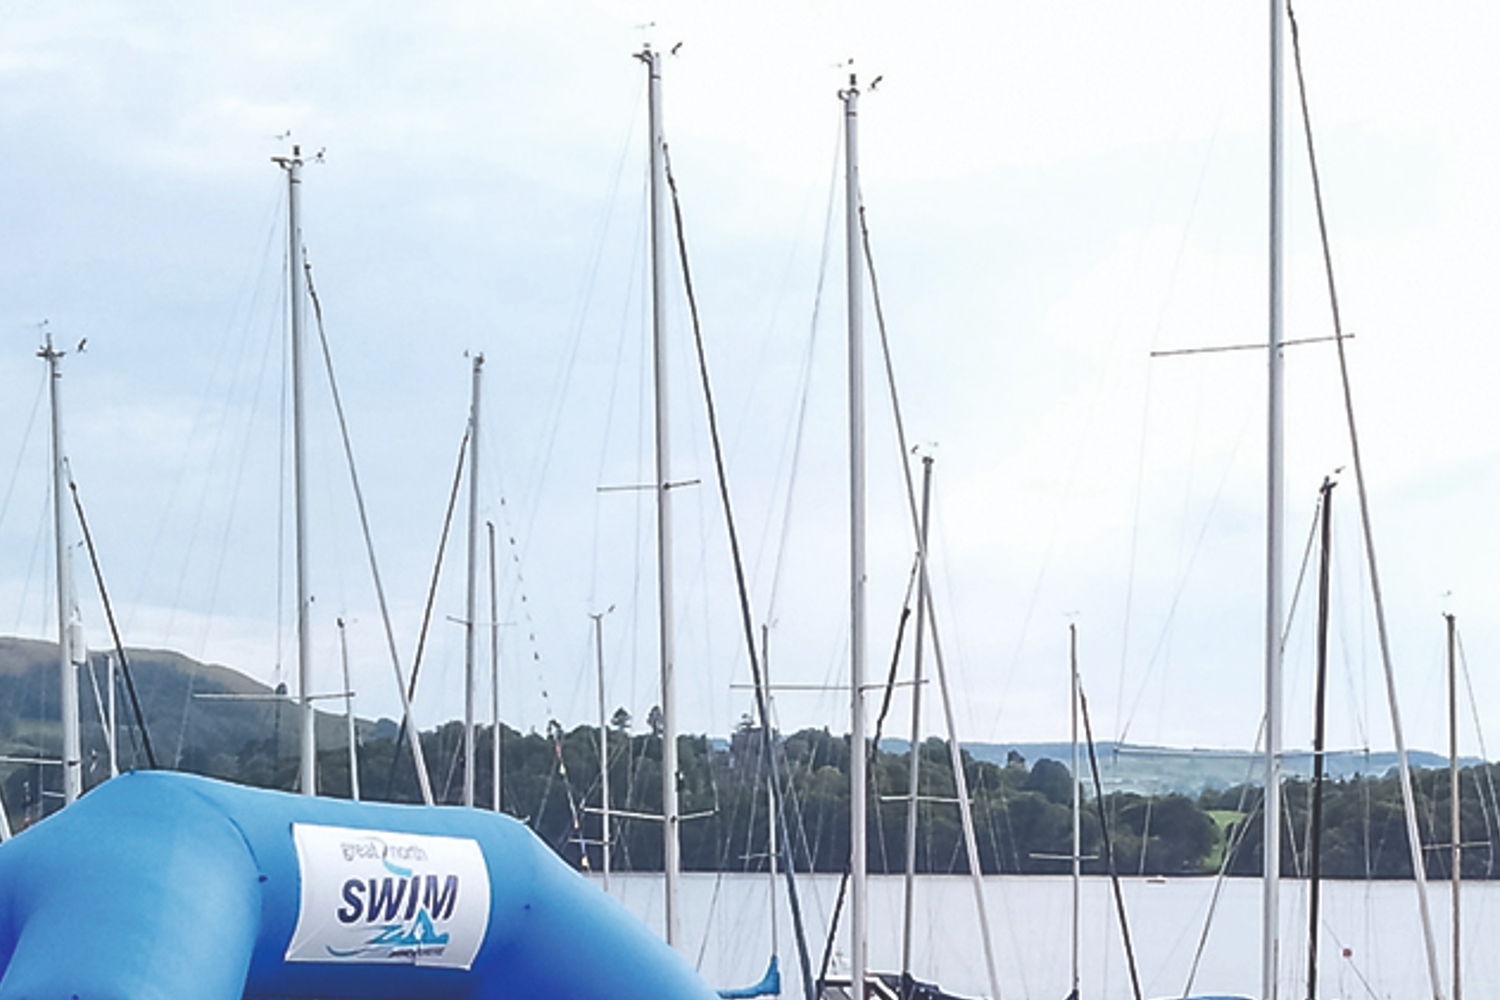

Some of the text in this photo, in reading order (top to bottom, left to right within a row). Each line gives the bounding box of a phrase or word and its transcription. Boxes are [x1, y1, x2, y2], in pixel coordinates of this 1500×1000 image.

[340, 842, 428, 861] great north
[337, 875, 458, 923] SWIM
